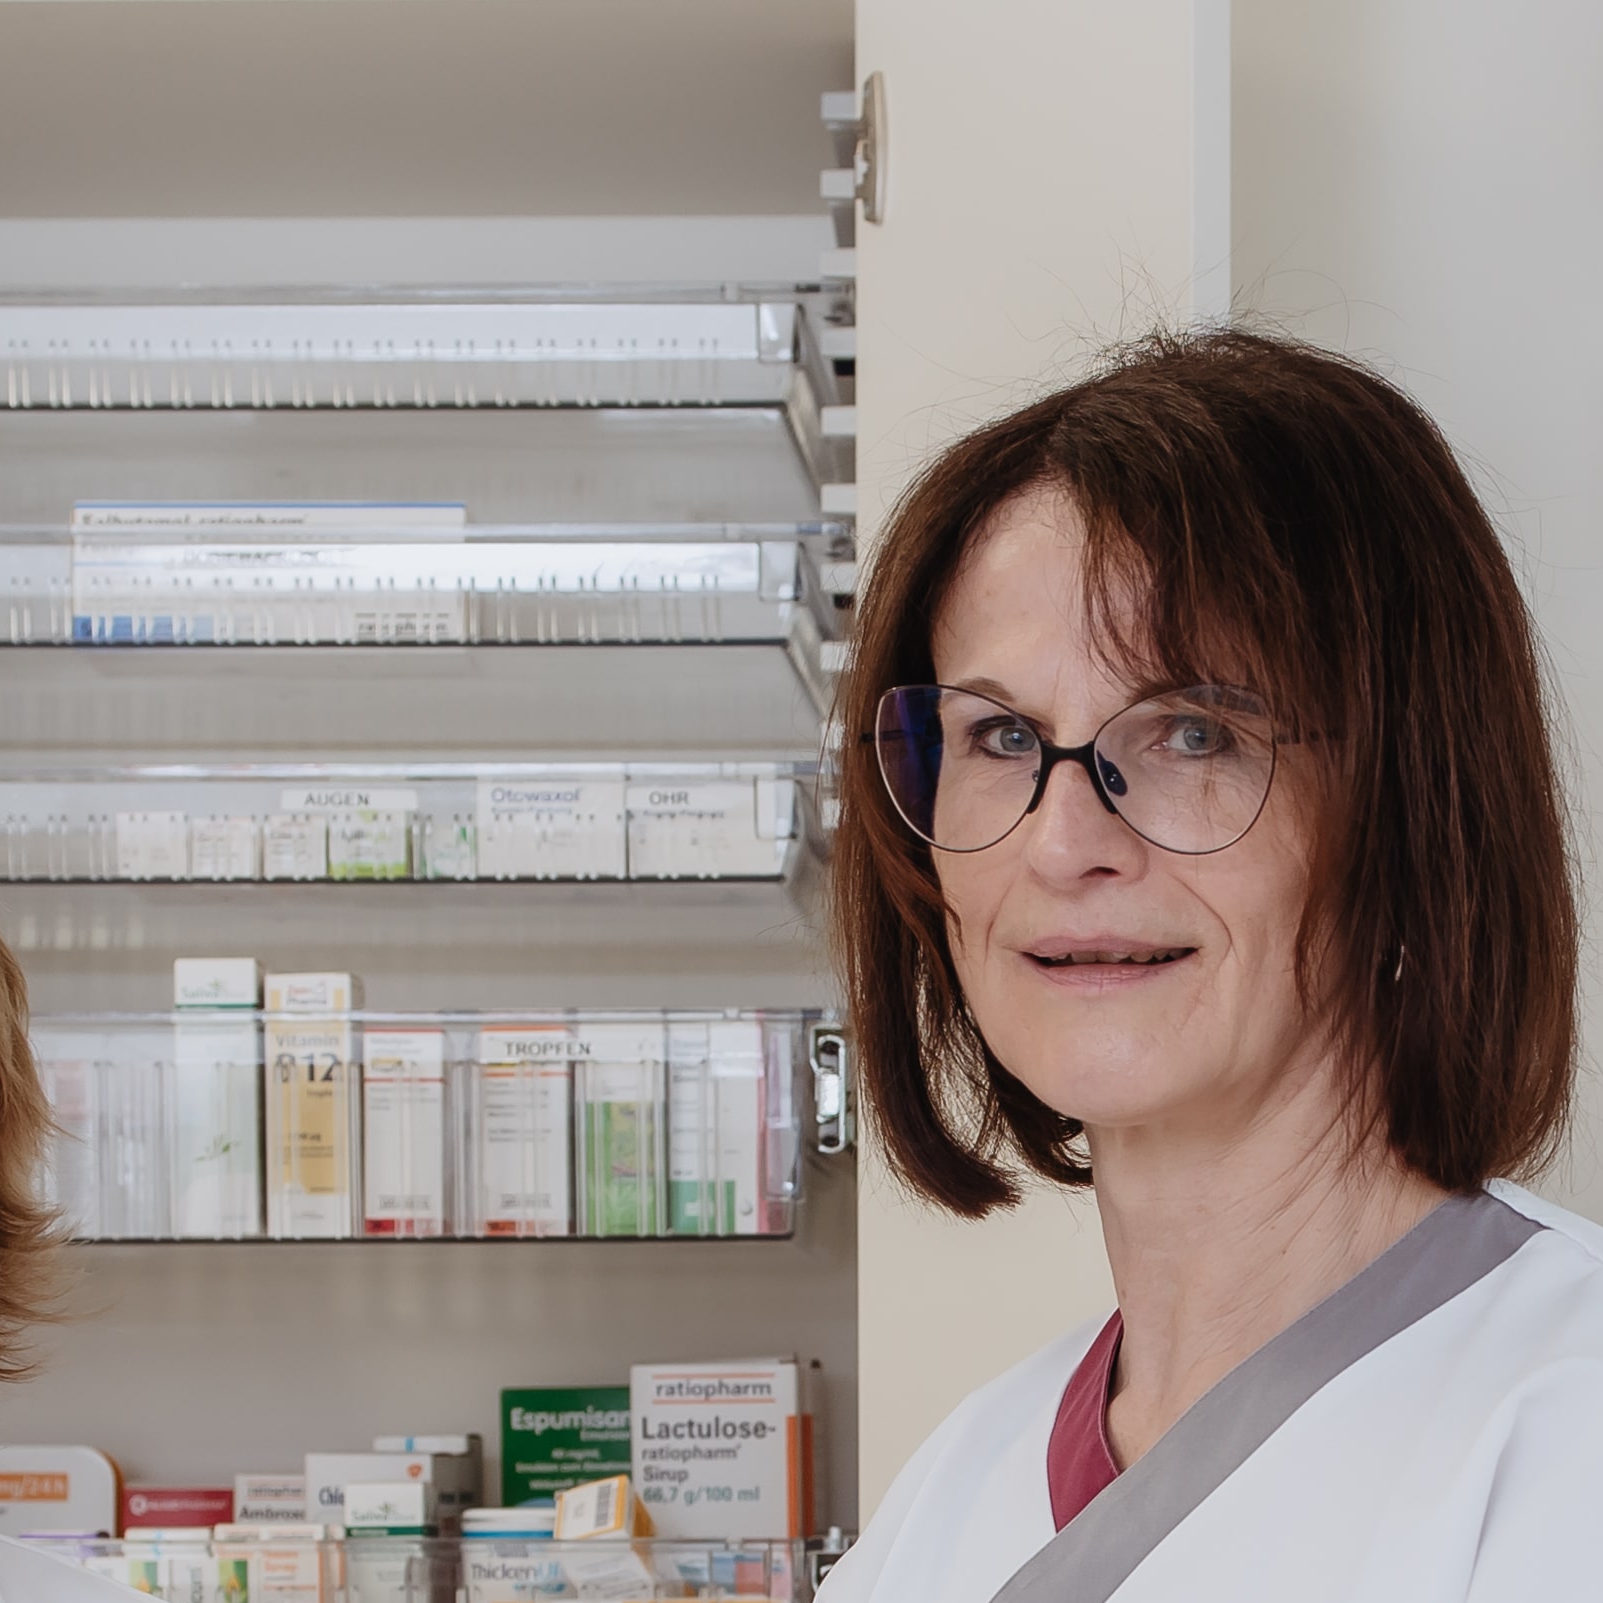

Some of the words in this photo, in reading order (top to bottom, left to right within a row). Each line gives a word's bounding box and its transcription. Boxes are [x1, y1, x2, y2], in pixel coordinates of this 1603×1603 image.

[305, 793, 369, 806] AUGEN
[649, 791, 689, 805] OHR
[275, 1033, 340, 1048] Vitamin
[506, 1042, 591, 1056] TROPFEN
[276, 1053, 342, 1083] B12
[655, 1382, 772, 1400] ratiopharm
[641, 1416, 776, 1440] Lactulose-
[641, 1444, 740, 1463] ratiopharm
[643, 1466, 689, 1485] Sirup
[737, 1486, 760, 1502] ml
